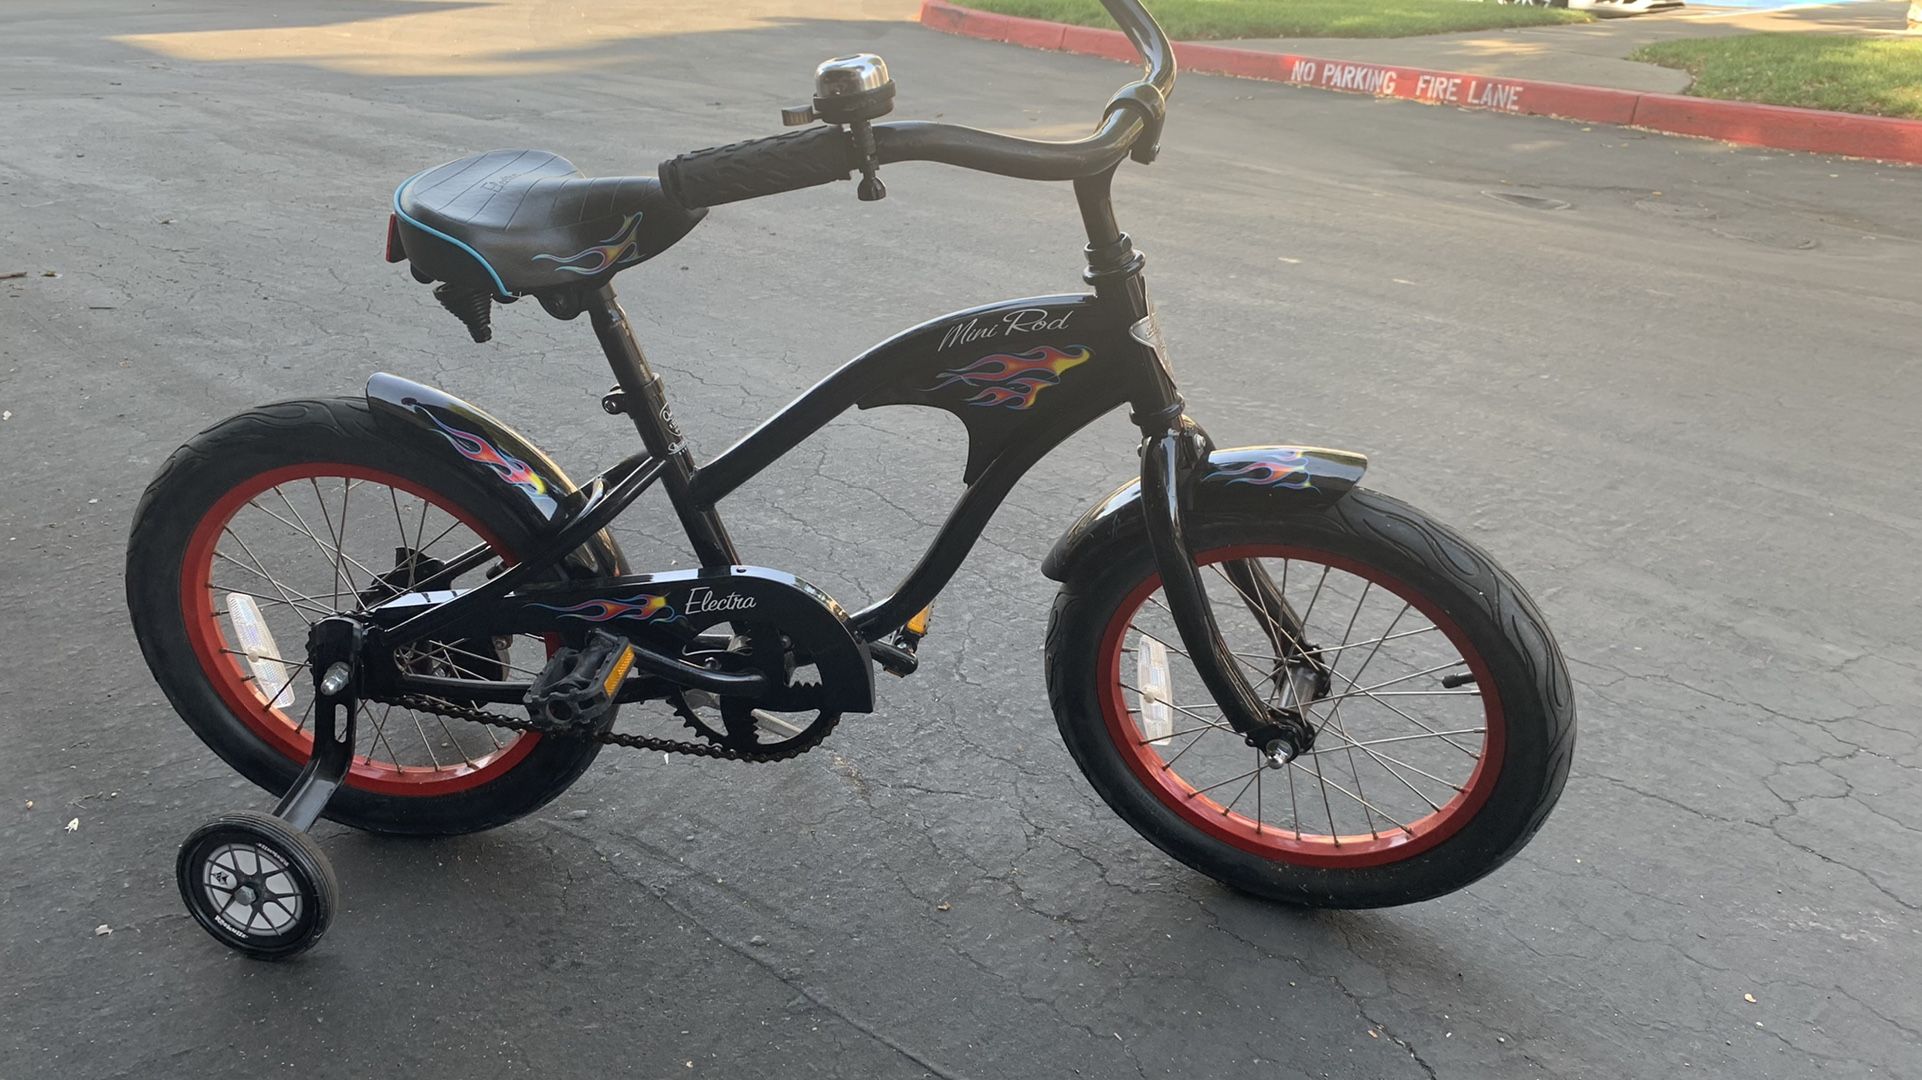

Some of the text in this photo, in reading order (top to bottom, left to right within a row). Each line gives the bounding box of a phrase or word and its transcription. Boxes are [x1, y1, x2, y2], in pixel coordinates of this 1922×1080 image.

[1291, 61, 1523, 110] NO PARKING FIRE LANE
[937, 308, 1074, 352] Mini Rod
[685, 586, 756, 615] Electra
